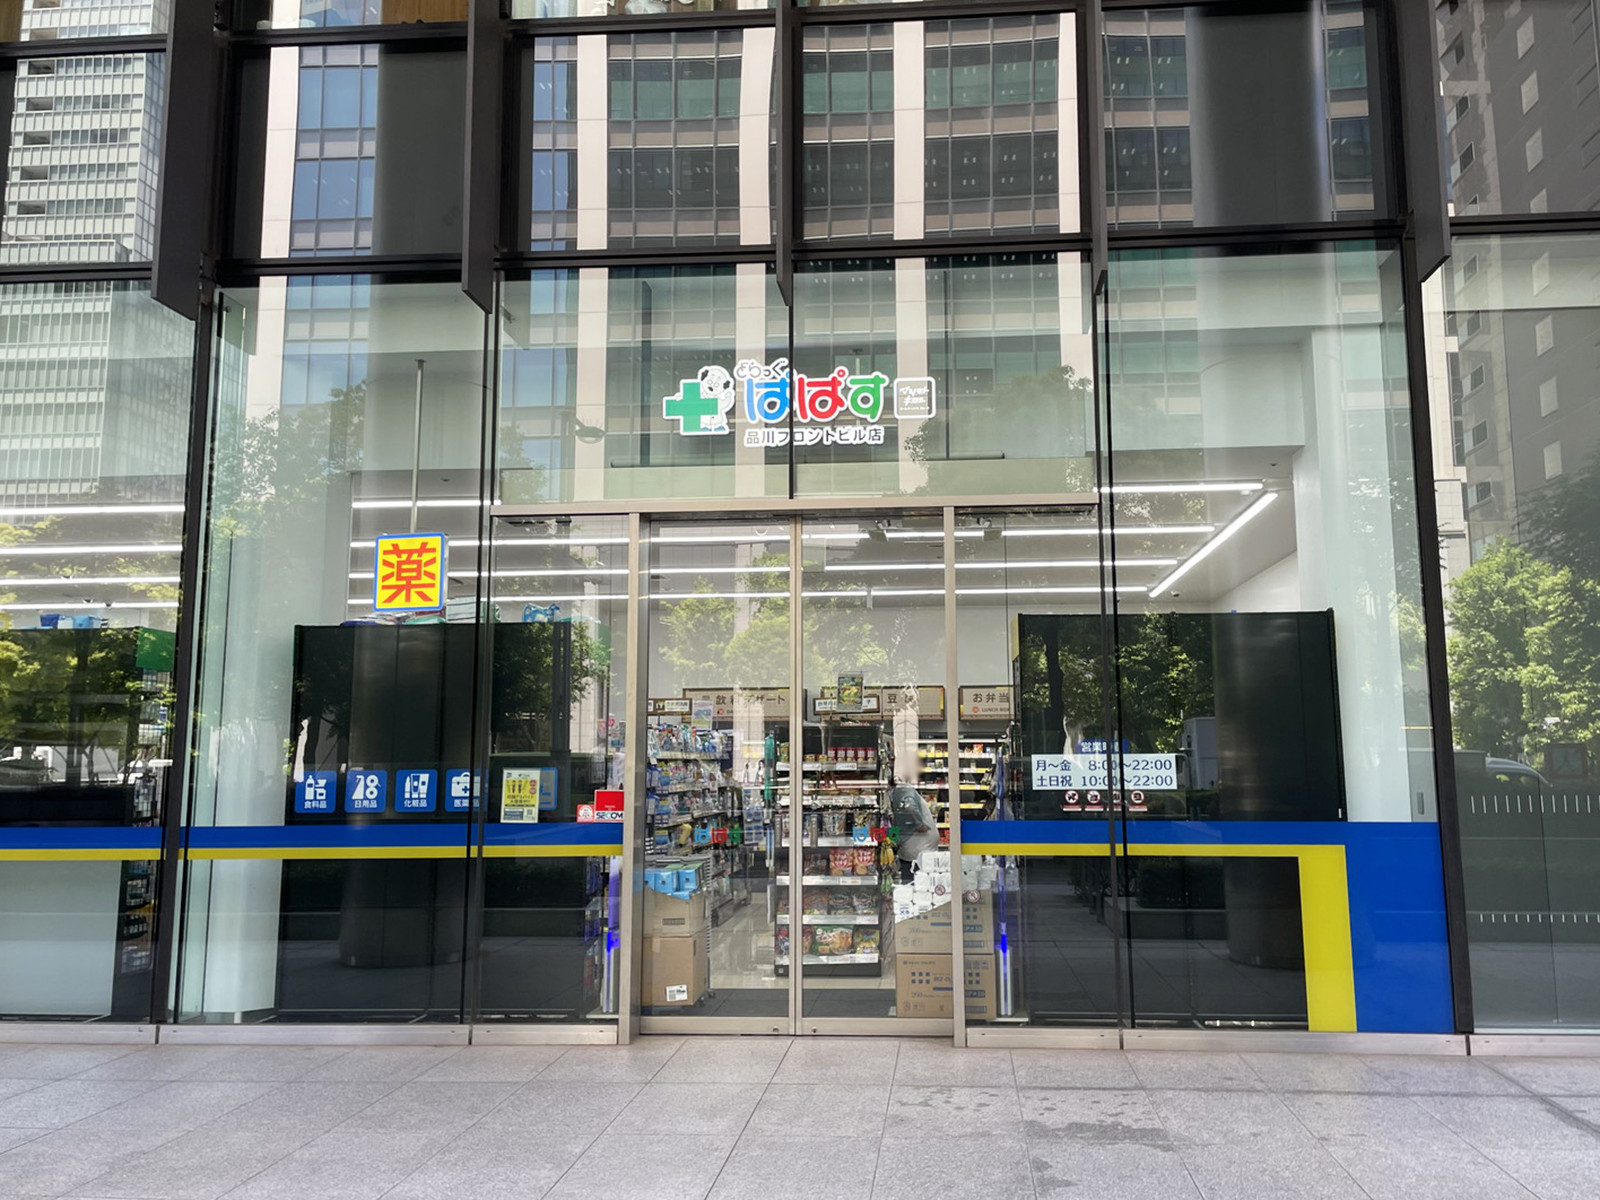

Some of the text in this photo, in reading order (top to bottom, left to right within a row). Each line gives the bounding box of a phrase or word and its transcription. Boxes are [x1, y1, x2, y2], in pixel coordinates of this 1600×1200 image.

[735, 359, 787, 379] どらっぐ
[745, 368, 887, 422] ぱぱす
[745, 428, 883, 446] 品川フロントビル店
[381, 541, 437, 604] 薬
[972, 692, 1010, 704] お弁当
[1035, 760, 1072, 772] 月～金
[1036, 775, 1073, 788] 土日祝
[304, 800, 327, 809] 食料品
[354, 799, 377, 809] 日用品
[404, 799, 427, 808] 化粧品
[595, 811, 624, 820] SECOM
